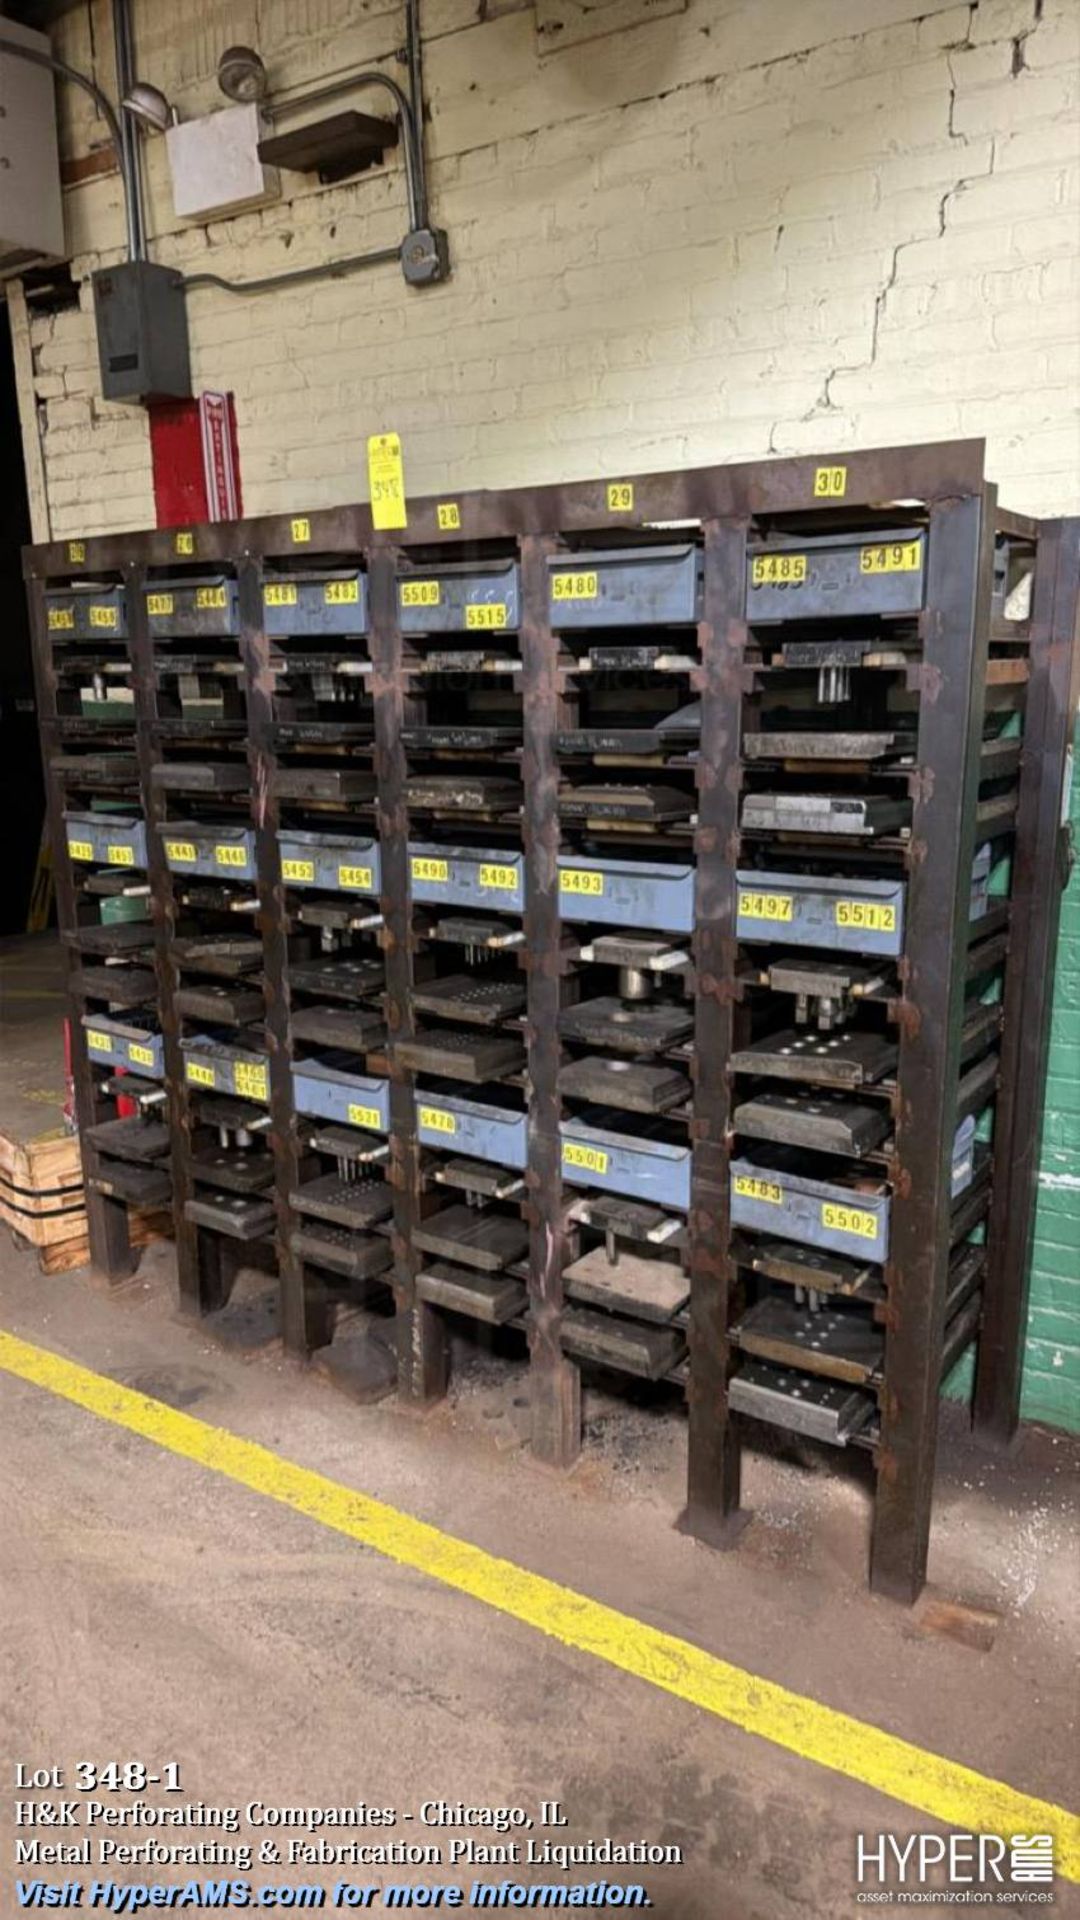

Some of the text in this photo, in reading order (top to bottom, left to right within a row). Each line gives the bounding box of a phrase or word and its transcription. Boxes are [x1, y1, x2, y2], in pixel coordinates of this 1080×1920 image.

[818, 471, 842, 491] 30
[610, 487, 631, 507] 29
[439, 506, 458, 526] 28
[292, 521, 309, 541] 27
[862, 545, 916, 568] 5491
[755, 556, 804, 578] 5485
[403, 585, 438, 602] 5509
[554, 576, 596, 595] 5480
[468, 608, 505, 625] 5515
[339, 869, 371, 886] 5454
[481, 867, 516, 885] 5492
[561, 875, 600, 892] 5493
[740, 896, 790, 916] 5497
[838, 902, 893, 927] 5512
[565, 1146, 604, 1169] 5501
[736, 1177, 780, 1200] 5483
[825, 1206, 873, 1234] 5502
